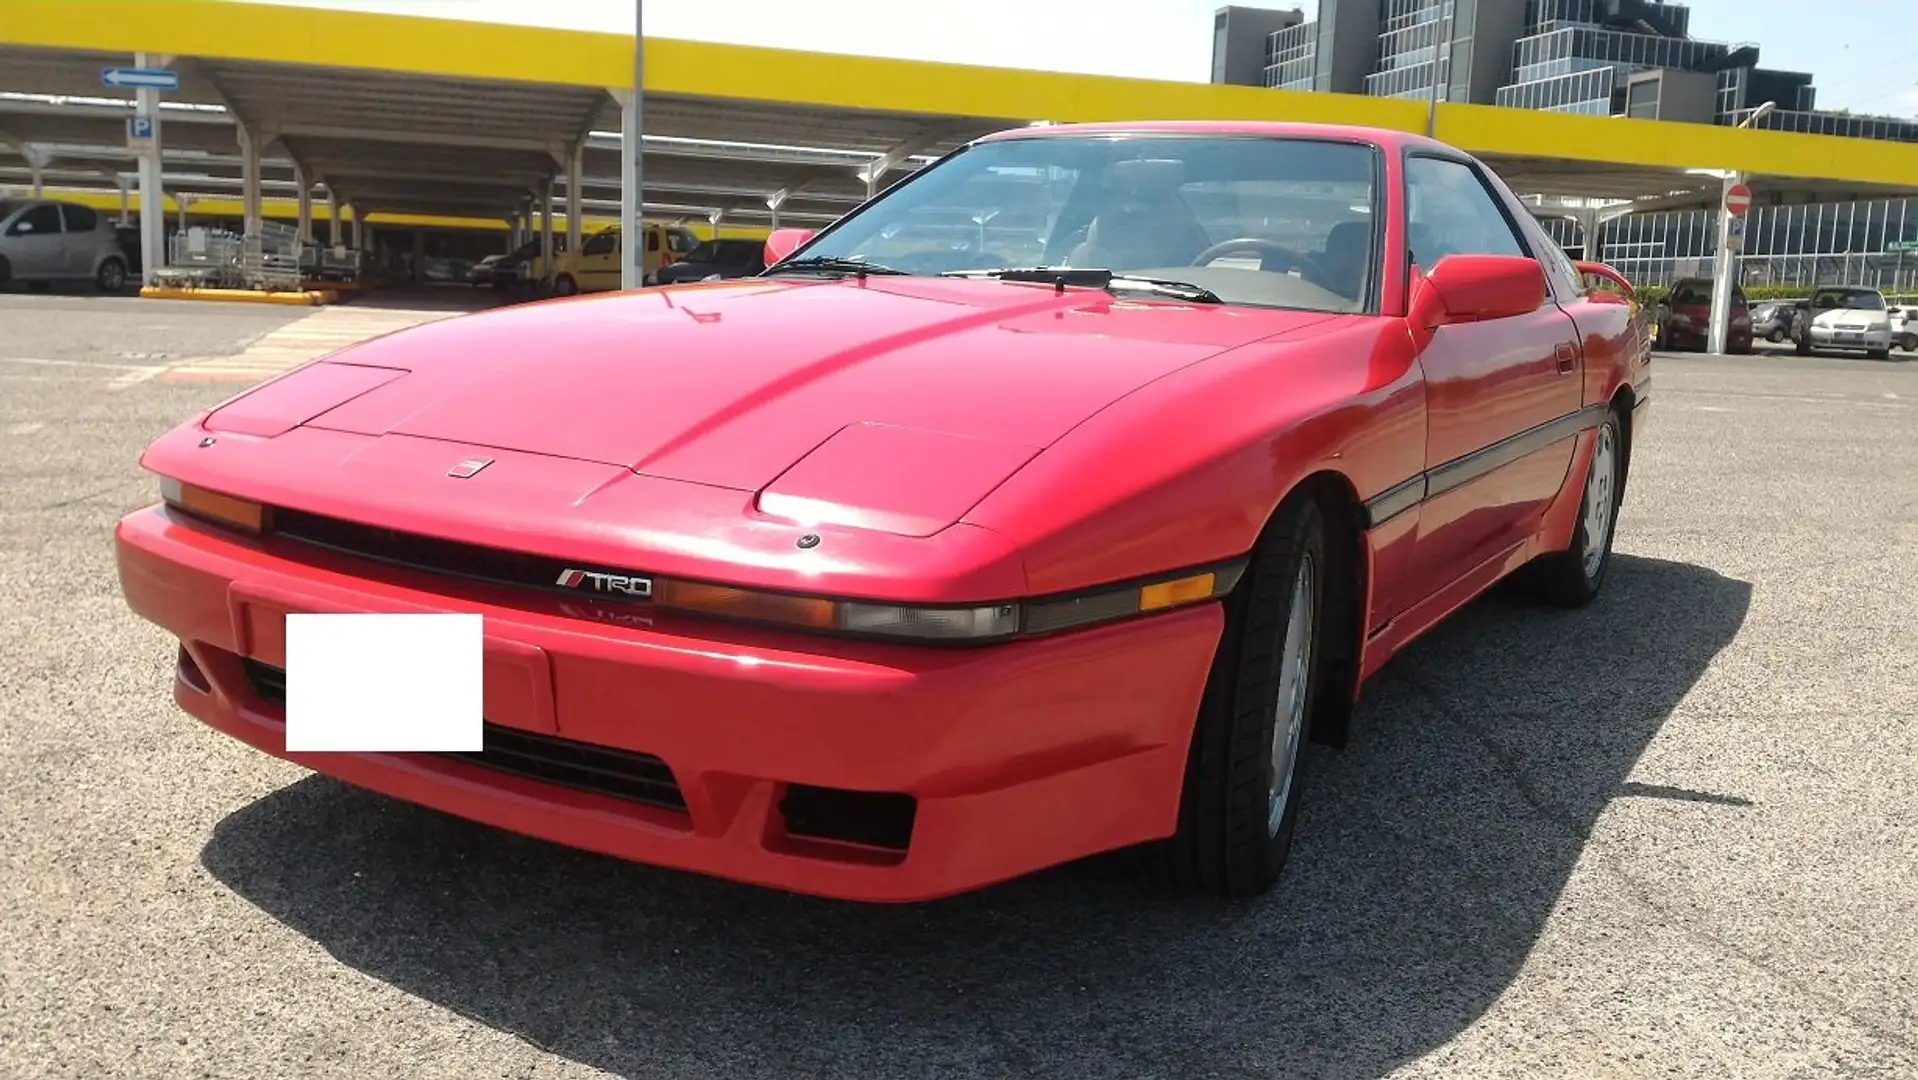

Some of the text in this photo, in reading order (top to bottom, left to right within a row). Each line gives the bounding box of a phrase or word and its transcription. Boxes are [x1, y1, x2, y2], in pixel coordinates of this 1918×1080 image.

[134, 119, 149, 136] P
[1733, 220, 1742, 235] P
[583, 571, 652, 597] TRD
